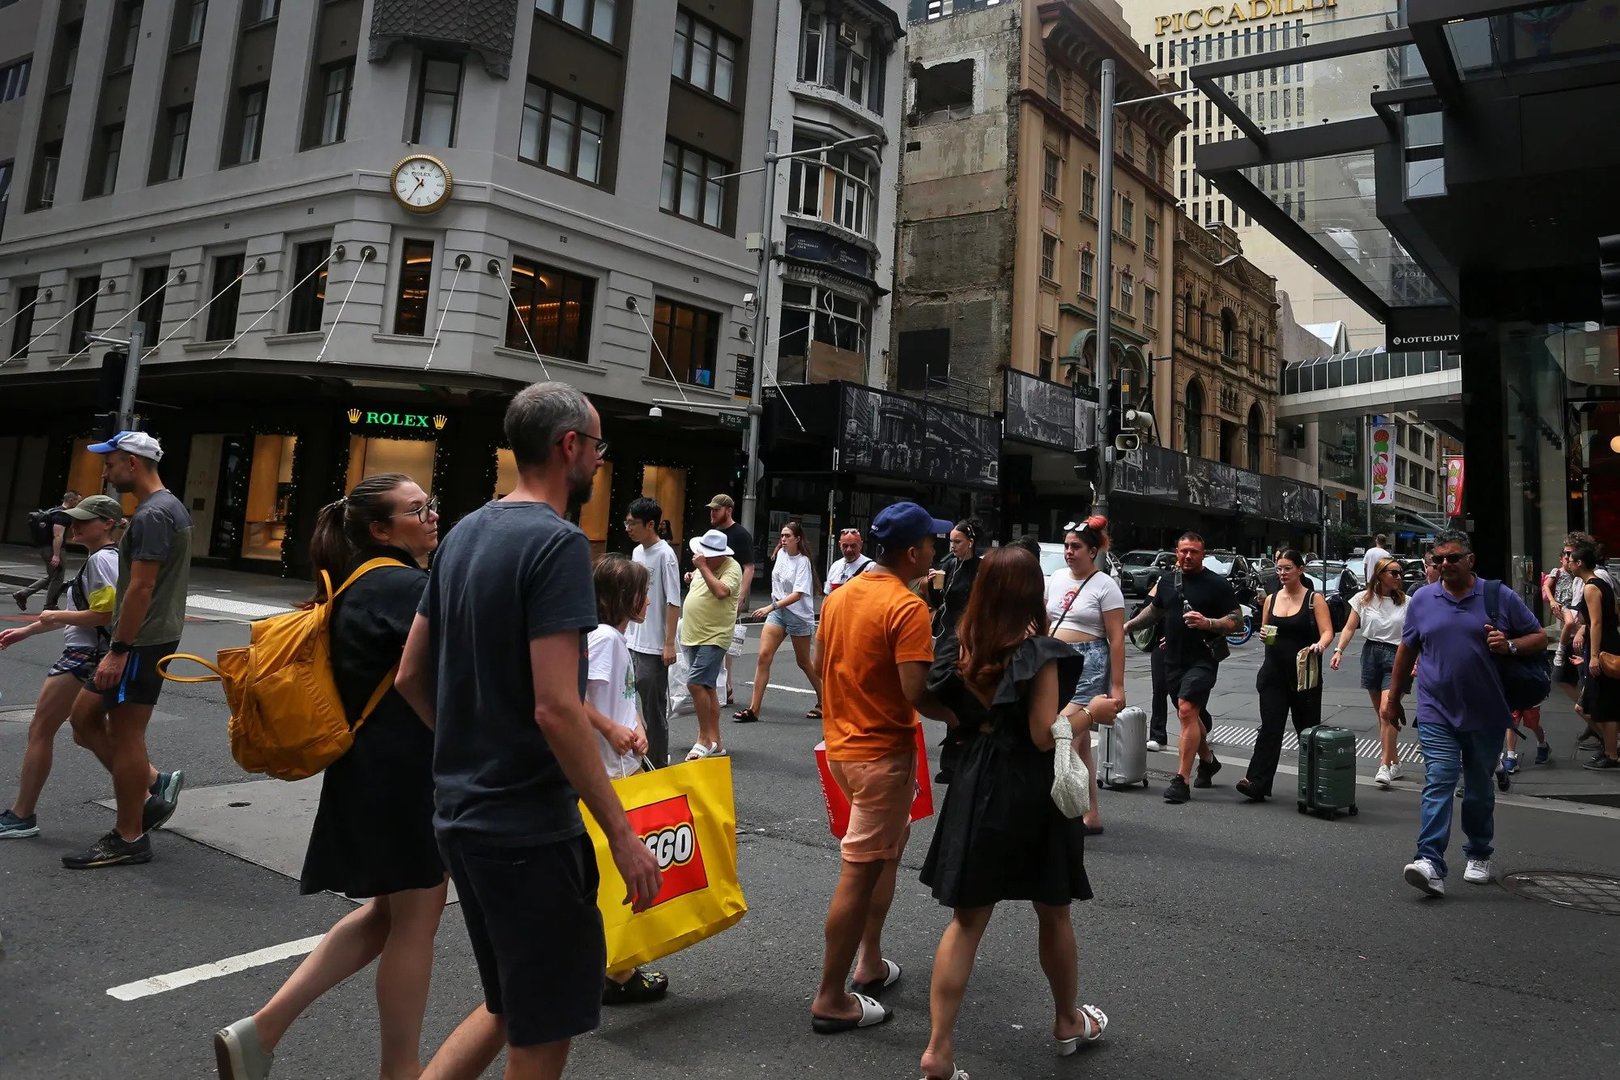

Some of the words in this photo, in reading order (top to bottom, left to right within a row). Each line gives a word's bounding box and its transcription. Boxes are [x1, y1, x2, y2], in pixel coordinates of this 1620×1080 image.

[1402, 336, 1432, 344] LOTTE
[1433, 334, 1460, 342] DUTY
[366, 411, 429, 428] ROLEX
[643, 824, 694, 870] EGO
